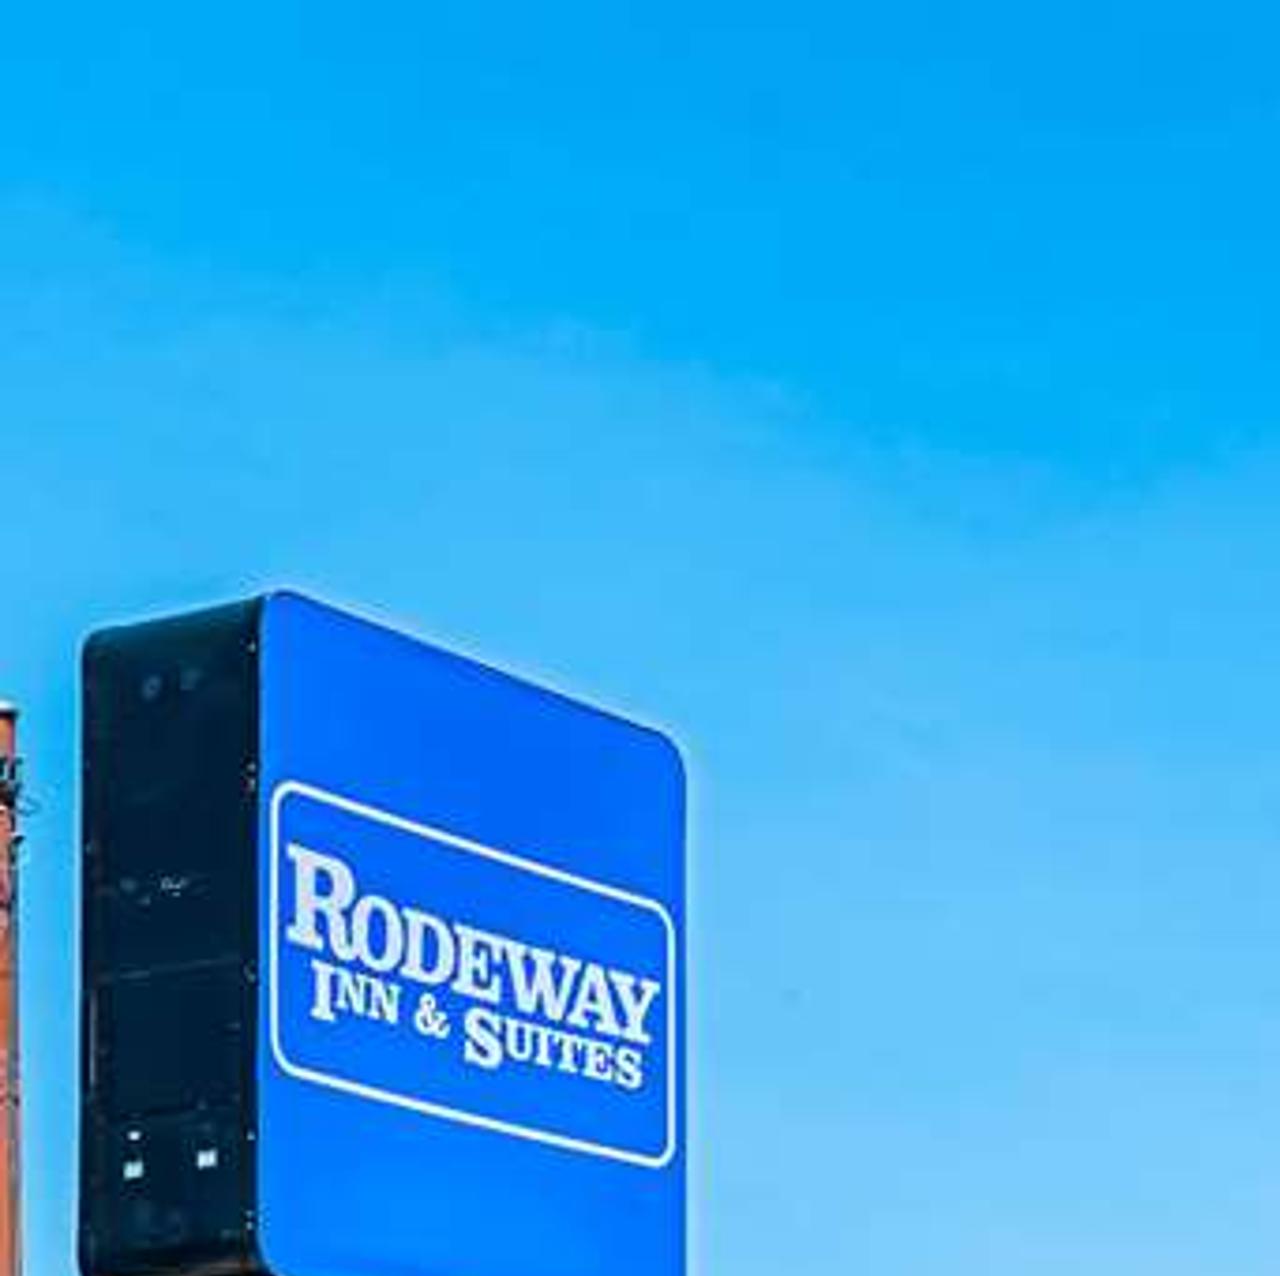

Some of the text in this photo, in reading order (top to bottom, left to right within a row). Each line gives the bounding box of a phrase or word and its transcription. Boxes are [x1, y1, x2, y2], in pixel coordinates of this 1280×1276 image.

[286, 842, 661, 1044] RODEWAY
[310, 960, 643, 1090] INN & SUITES
